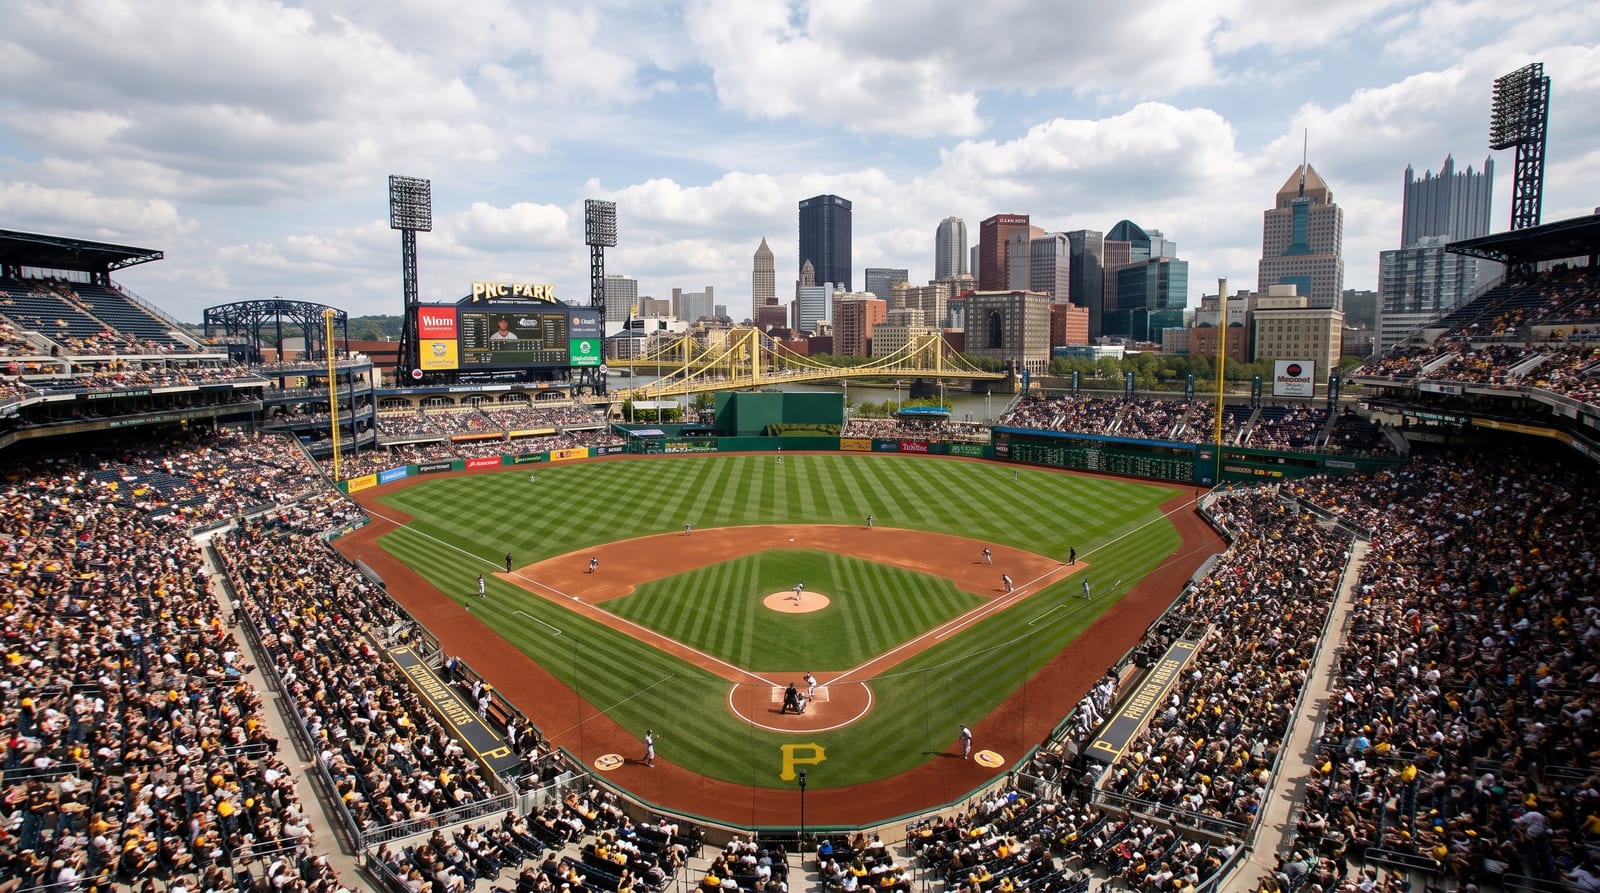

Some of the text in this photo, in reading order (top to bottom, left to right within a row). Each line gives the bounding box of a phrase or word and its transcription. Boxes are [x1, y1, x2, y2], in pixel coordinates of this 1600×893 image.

[472, 282, 556, 304] PNC PARK
[481, 746, 511, 759] P
[1093, 740, 1121, 755] P
[780, 742, 827, 781] P
